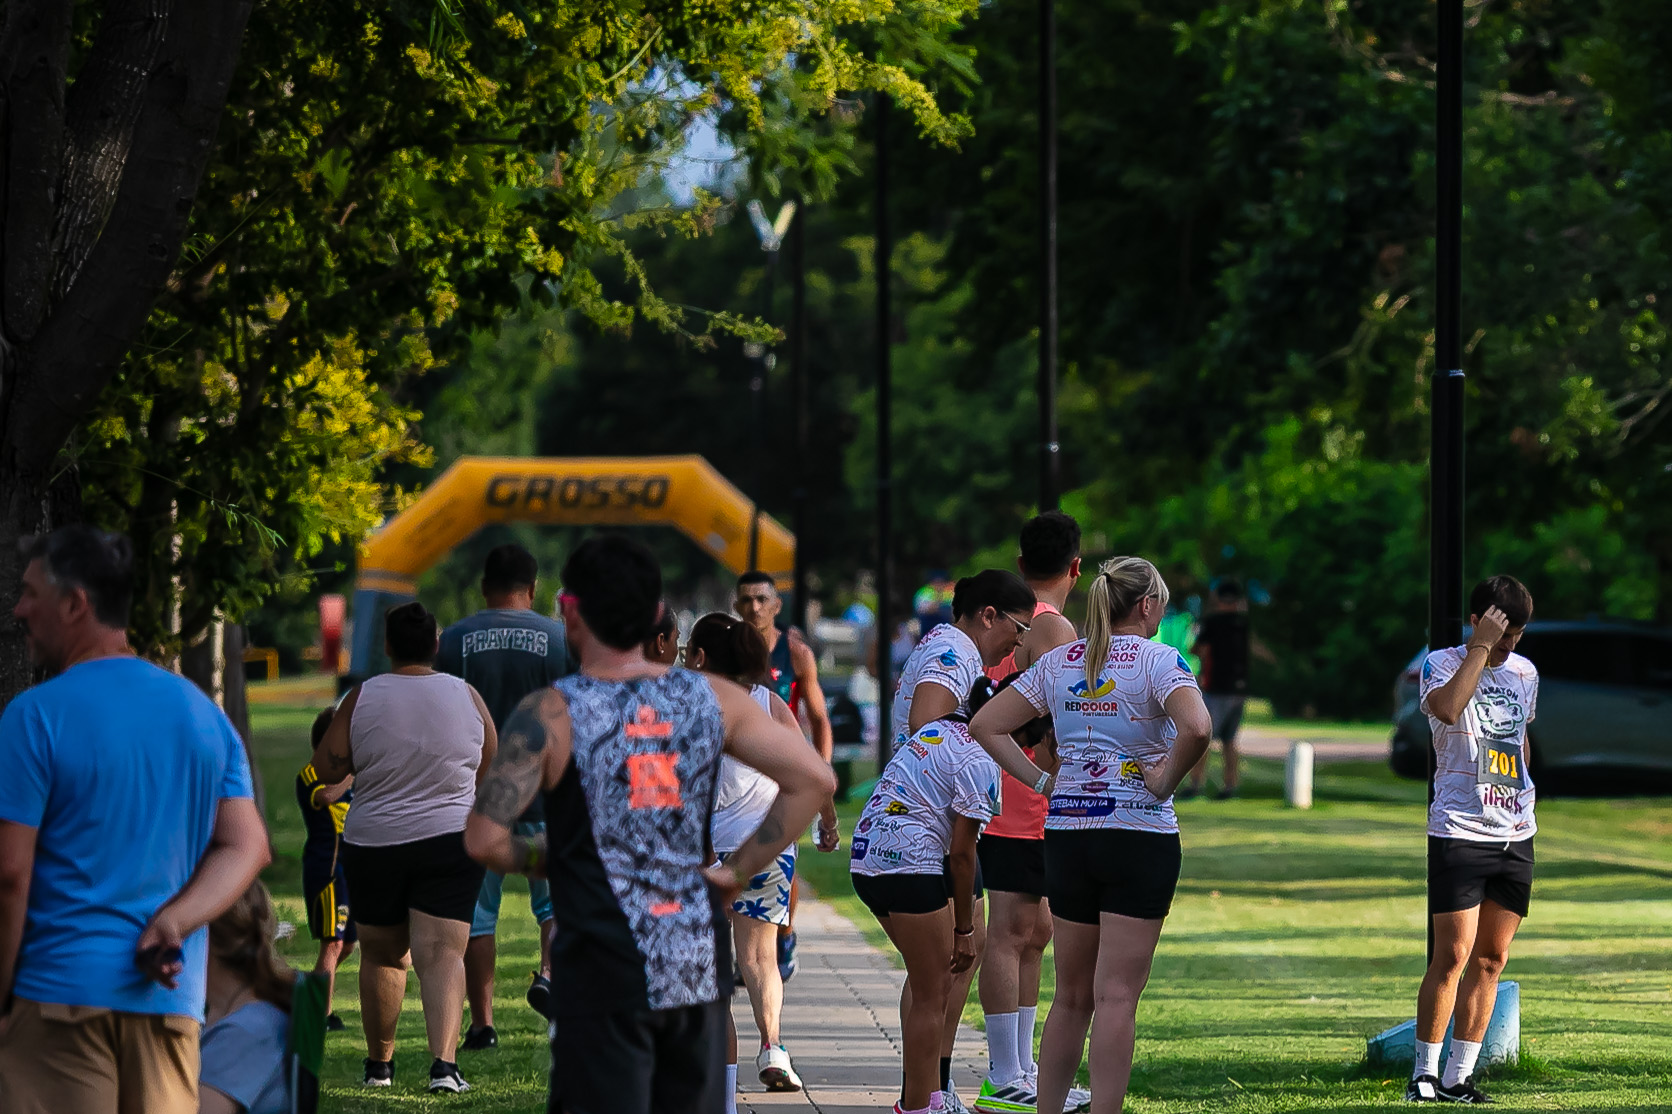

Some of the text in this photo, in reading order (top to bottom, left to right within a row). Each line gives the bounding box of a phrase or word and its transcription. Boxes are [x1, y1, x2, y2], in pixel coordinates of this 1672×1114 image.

[485, 473, 671, 508] GROSSO
[462, 627, 549, 658] PRAYERS
[1064, 700, 1119, 712] REDCOLOR
[1488, 749, 1518, 778] 701
